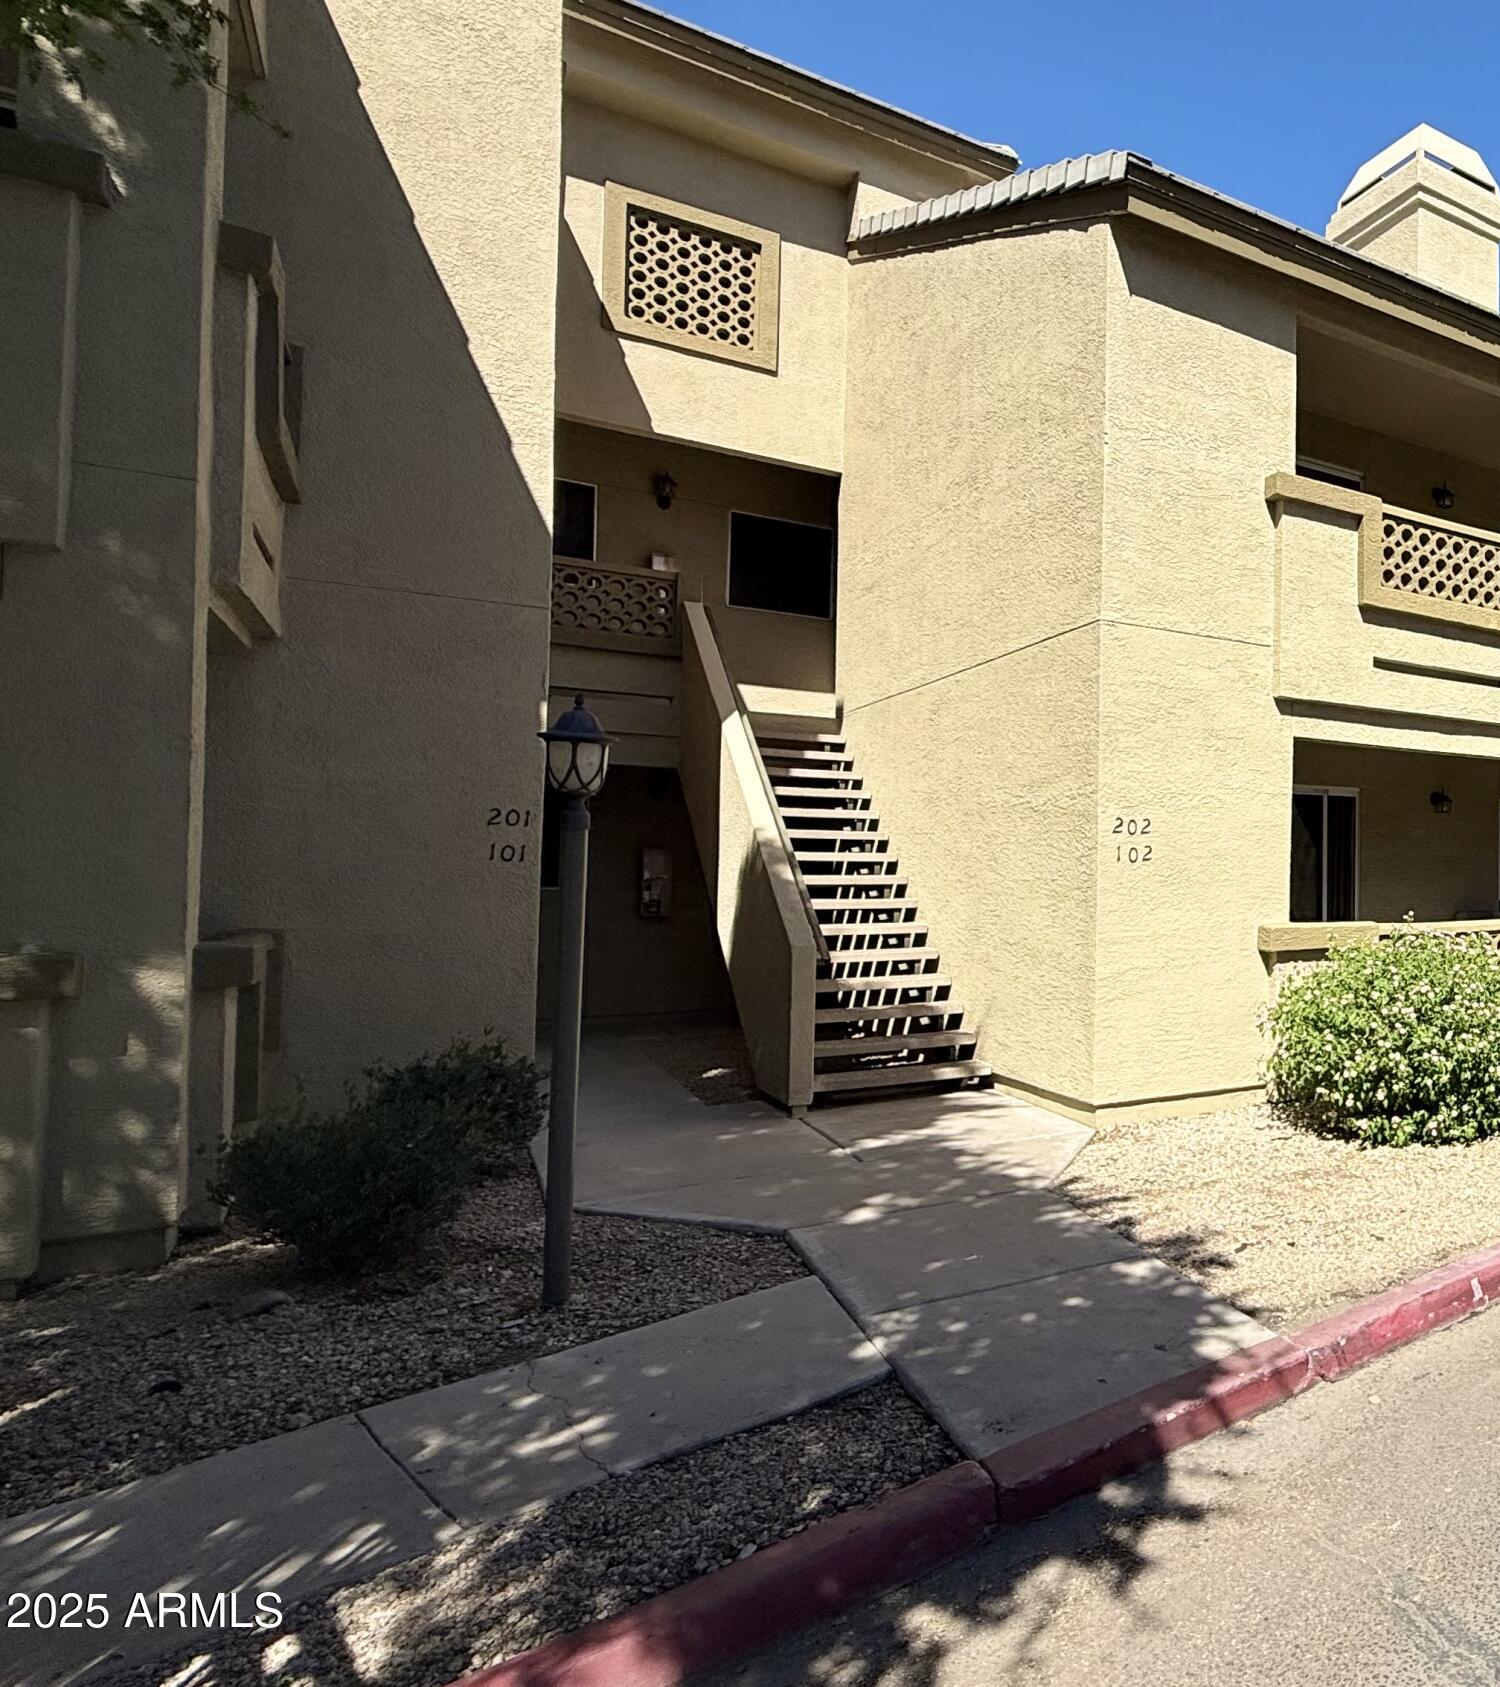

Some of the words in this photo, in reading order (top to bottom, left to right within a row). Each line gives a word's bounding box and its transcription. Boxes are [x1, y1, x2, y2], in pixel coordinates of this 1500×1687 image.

[487, 808, 531, 828] 201
[1112, 816, 1151, 836] 202
[489, 842, 526, 863] 101
[1116, 845, 1152, 863] 102
